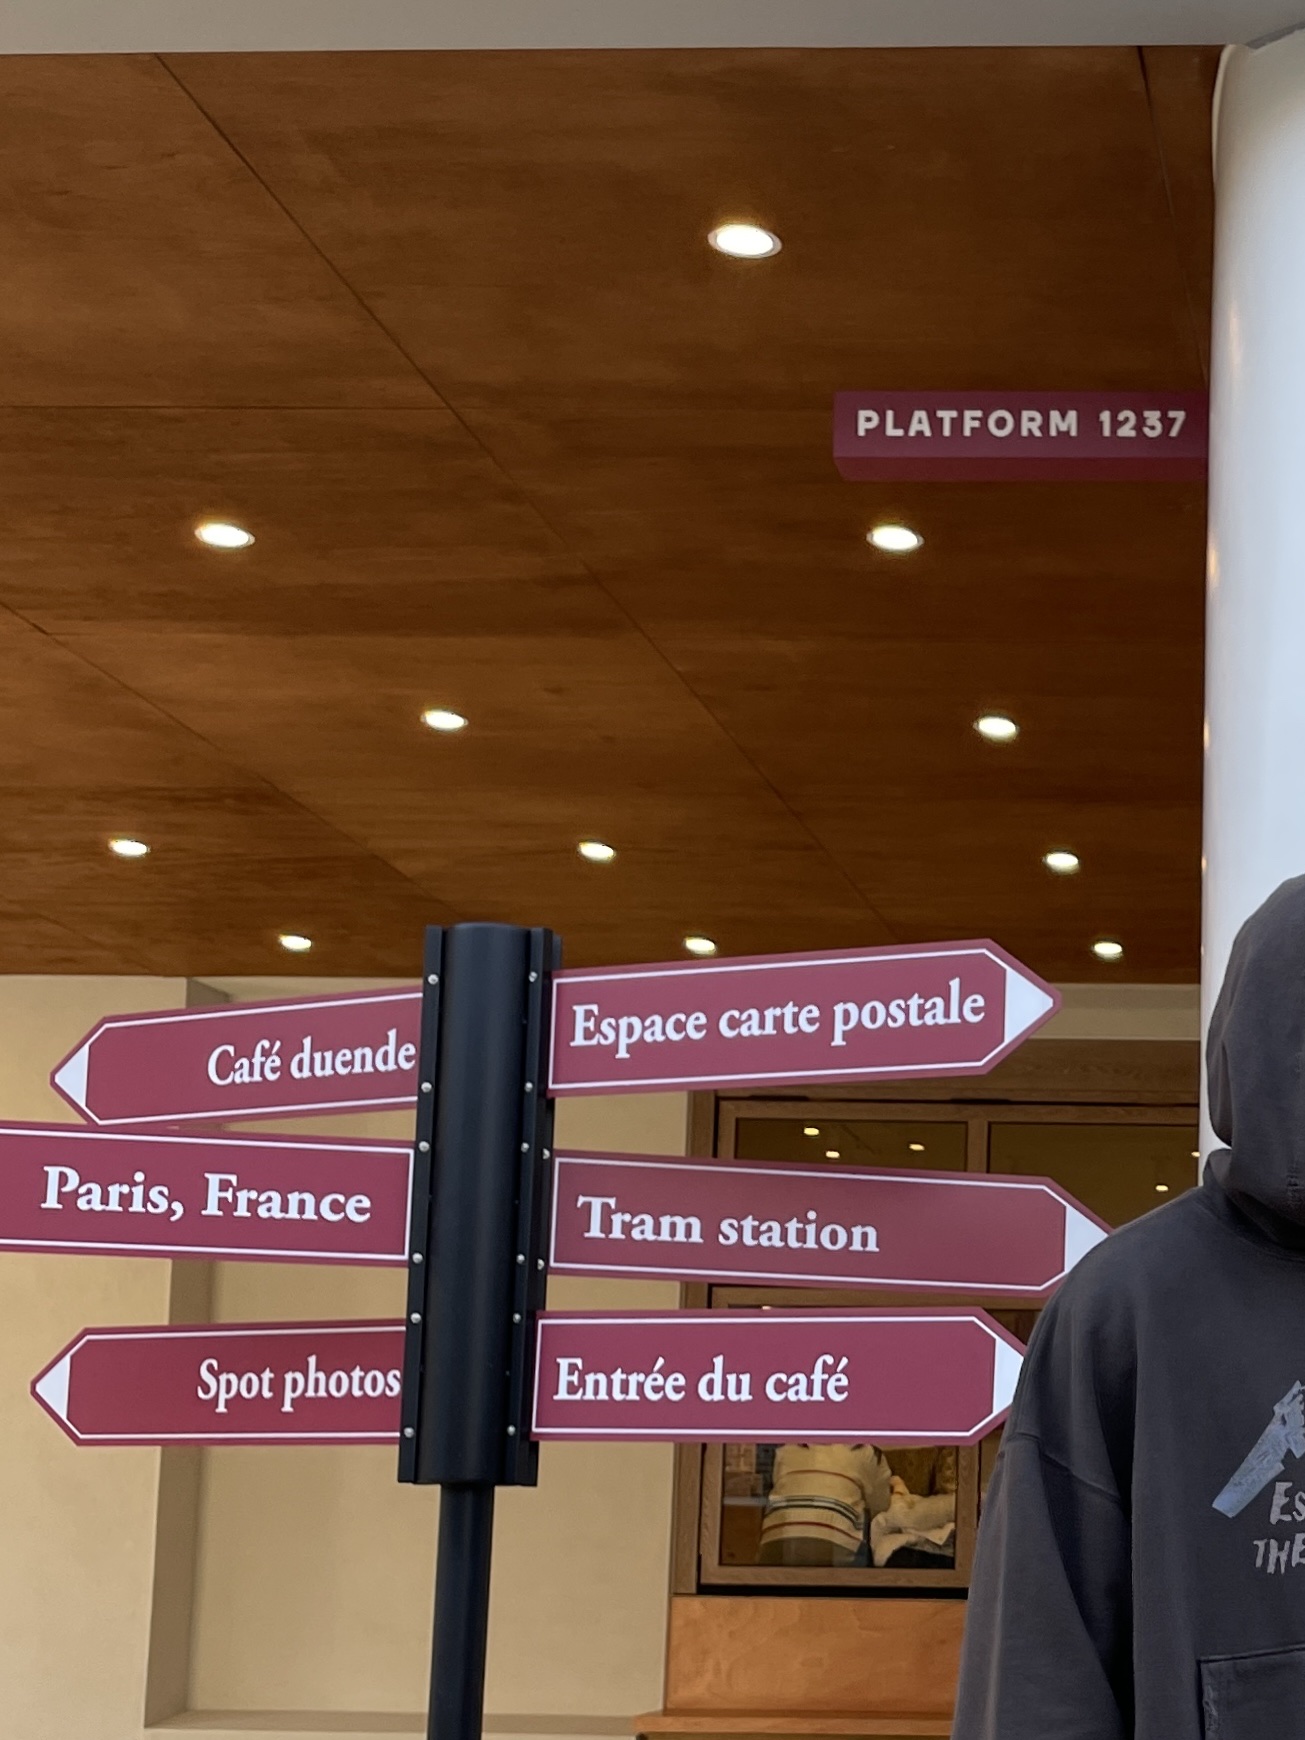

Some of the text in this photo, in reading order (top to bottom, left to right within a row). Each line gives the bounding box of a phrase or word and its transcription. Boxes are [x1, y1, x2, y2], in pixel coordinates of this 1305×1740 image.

[857, 409, 1187, 437] PLATFORM 1237
[569, 977, 985, 1059] Espace carte postale
[207, 1029, 417, 1086] Café duende
[40, 1166, 372, 1223] Paris, France
[577, 1195, 880, 1253] Tram station
[197, 1354, 402, 1413] Spot photos
[553, 1353, 850, 1403] Entrée du café
